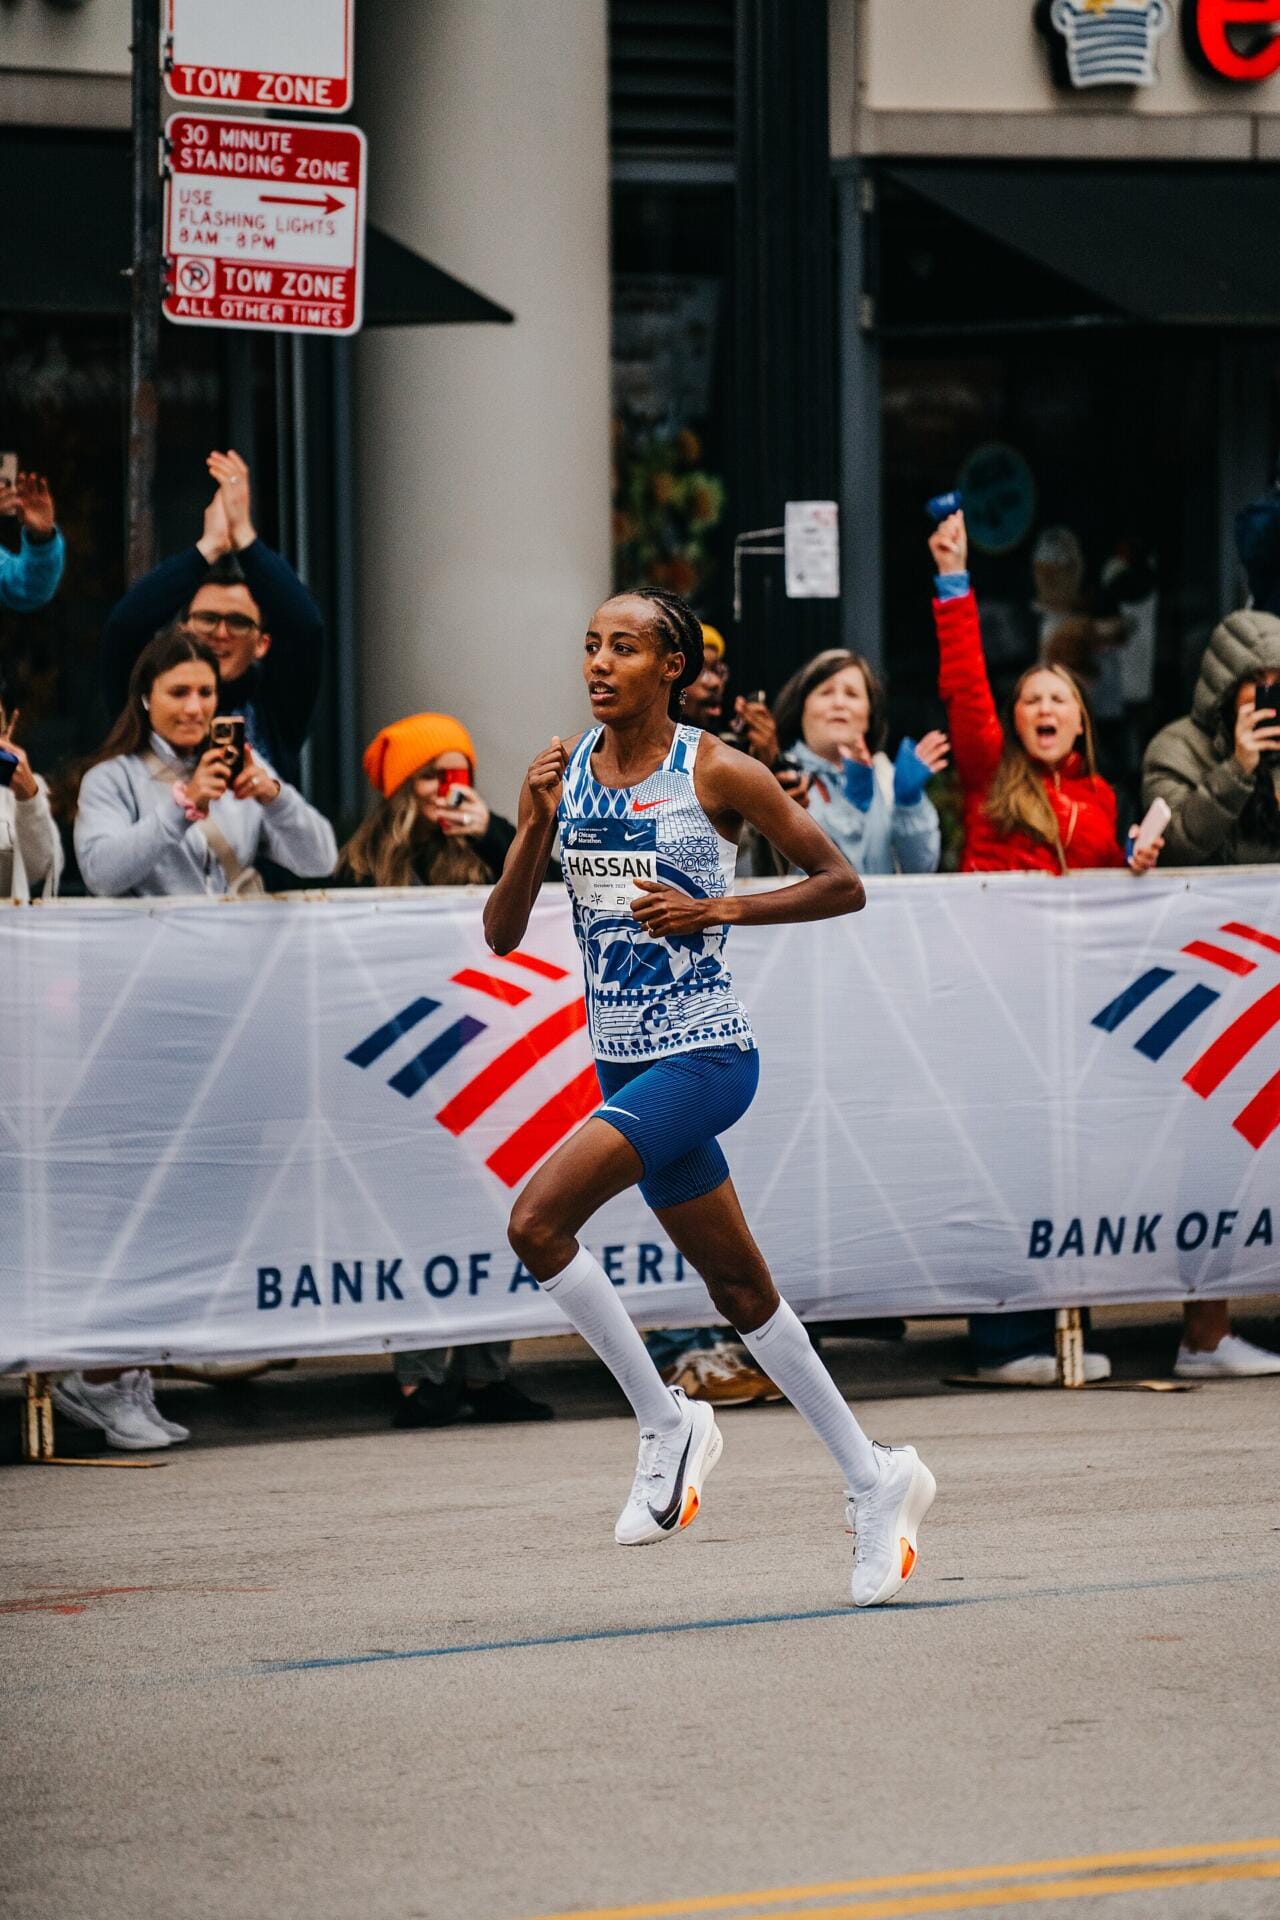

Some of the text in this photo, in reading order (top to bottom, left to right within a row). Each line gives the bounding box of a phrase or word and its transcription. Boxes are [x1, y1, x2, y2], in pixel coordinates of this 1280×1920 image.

[180, 67, 332, 105] TOW ZONE
[181, 123, 292, 153] 30 MINUTE
[180, 151, 350, 182] STANDING ZONE
[179, 189, 213, 206] USE
[179, 208, 335, 235] FLASHING LIGHTS
[223, 267, 346, 299] TOW ZONE
[176, 298, 343, 326] ALL OTHER TIMES
[567, 856, 652, 878] HASSAN
[1028, 1207, 1273, 1259] BANK OF A
[256, 1243, 685, 1310] BANK OF AERI
